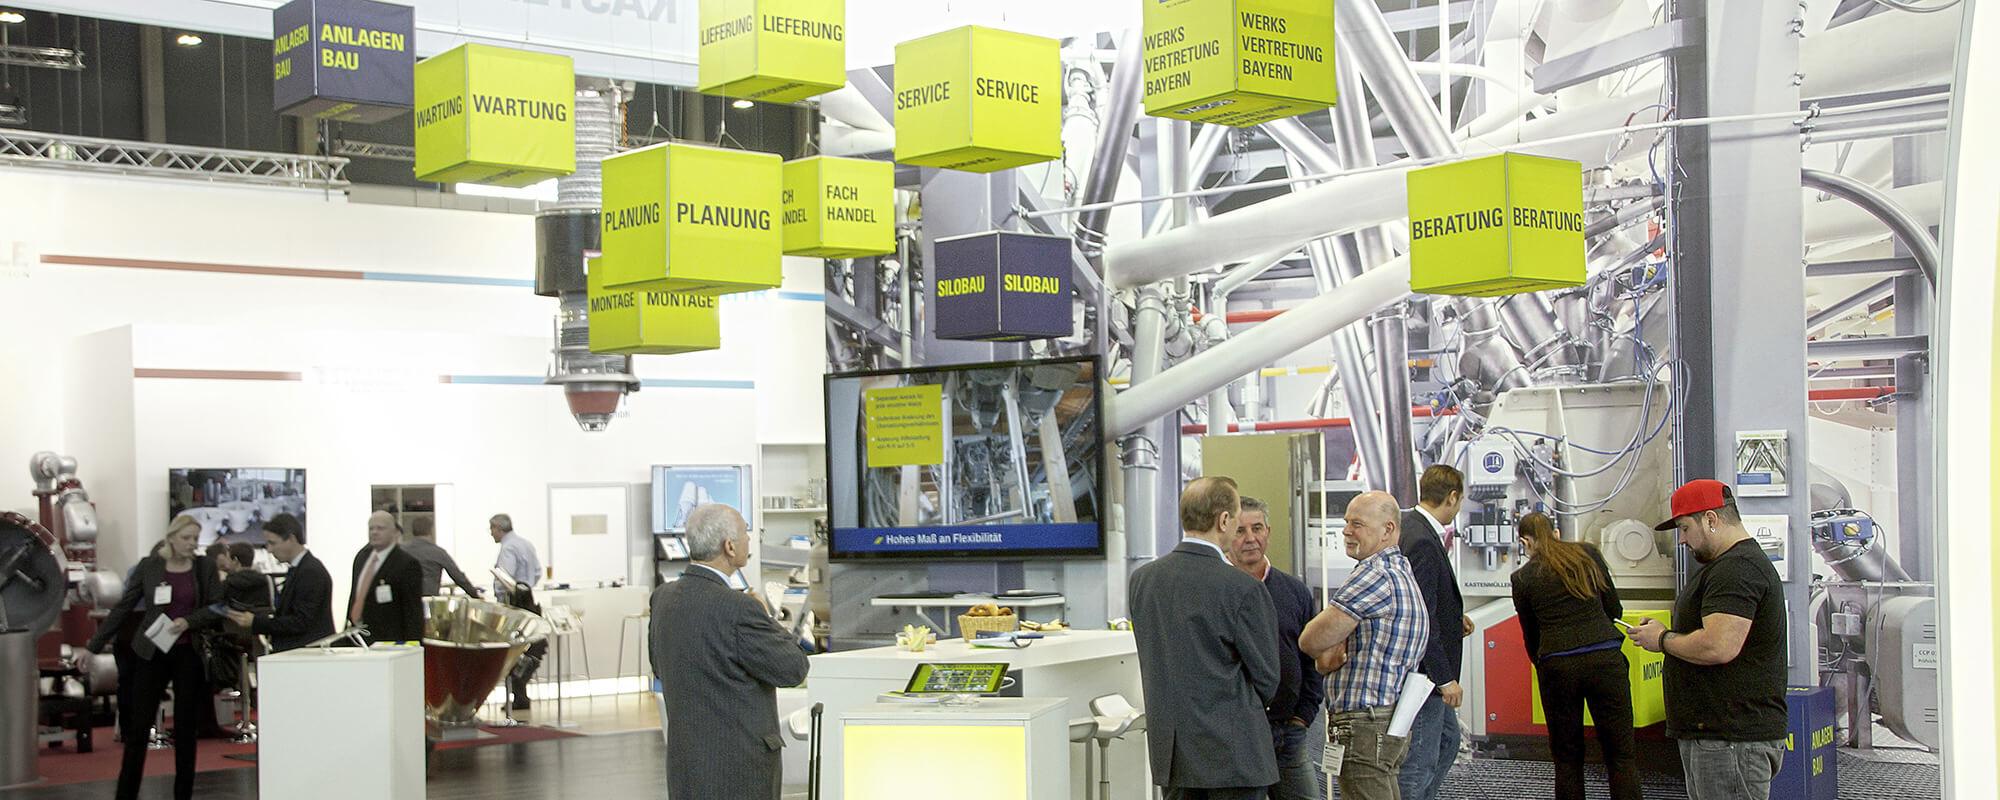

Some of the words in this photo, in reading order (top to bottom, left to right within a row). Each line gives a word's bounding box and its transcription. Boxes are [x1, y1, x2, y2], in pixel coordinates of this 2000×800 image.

[702, 15, 753, 46] LIEFERUNG
[763, 14, 843, 42] LIEFERUNG
[1241, 11, 1287, 34] WERKS
[275, 23, 309, 56] ANLAGEN
[321, 23, 405, 52] ANLAGEN
[1145, 26, 1185, 51] WERKS
[1241, 35, 1323, 63] VERTRETUNG
[275, 57, 291, 80] BAU
[322, 48, 359, 71] BAU
[1145, 40, 1220, 74] VERTRETUNG
[1243, 59, 1293, 81] BAYERN
[897, 81, 950, 110] SERVICE
[976, 77, 1039, 104] SERVICE
[1146, 70, 1191, 96] BAYERN
[416, 95, 463, 128] WARTUNG
[473, 94, 567, 122] WARTUNG
[782, 189, 794, 205] CH
[826, 184, 858, 201] FACH
[605, 202, 660, 232] PLANUNG
[677, 202, 770, 231] PLANUNG
[782, 208, 808, 225] NDEL
[827, 206, 877, 223] HANDEL
[1412, 207, 1503, 240] BERATUNG
[1513, 206, 1582, 232] BERATUNG
[937, 275, 985, 297] SILOBAU
[1004, 274, 1060, 294] SILOBAU
[591, 291, 635, 313] MONTAGE
[647, 292, 714, 308] MONTAGE
[886, 534, 916, 545] Hohes
[917, 533, 938, 545] Maß
[939, 534, 952, 544] an
[953, 532, 1003, 543] Flexibilität
